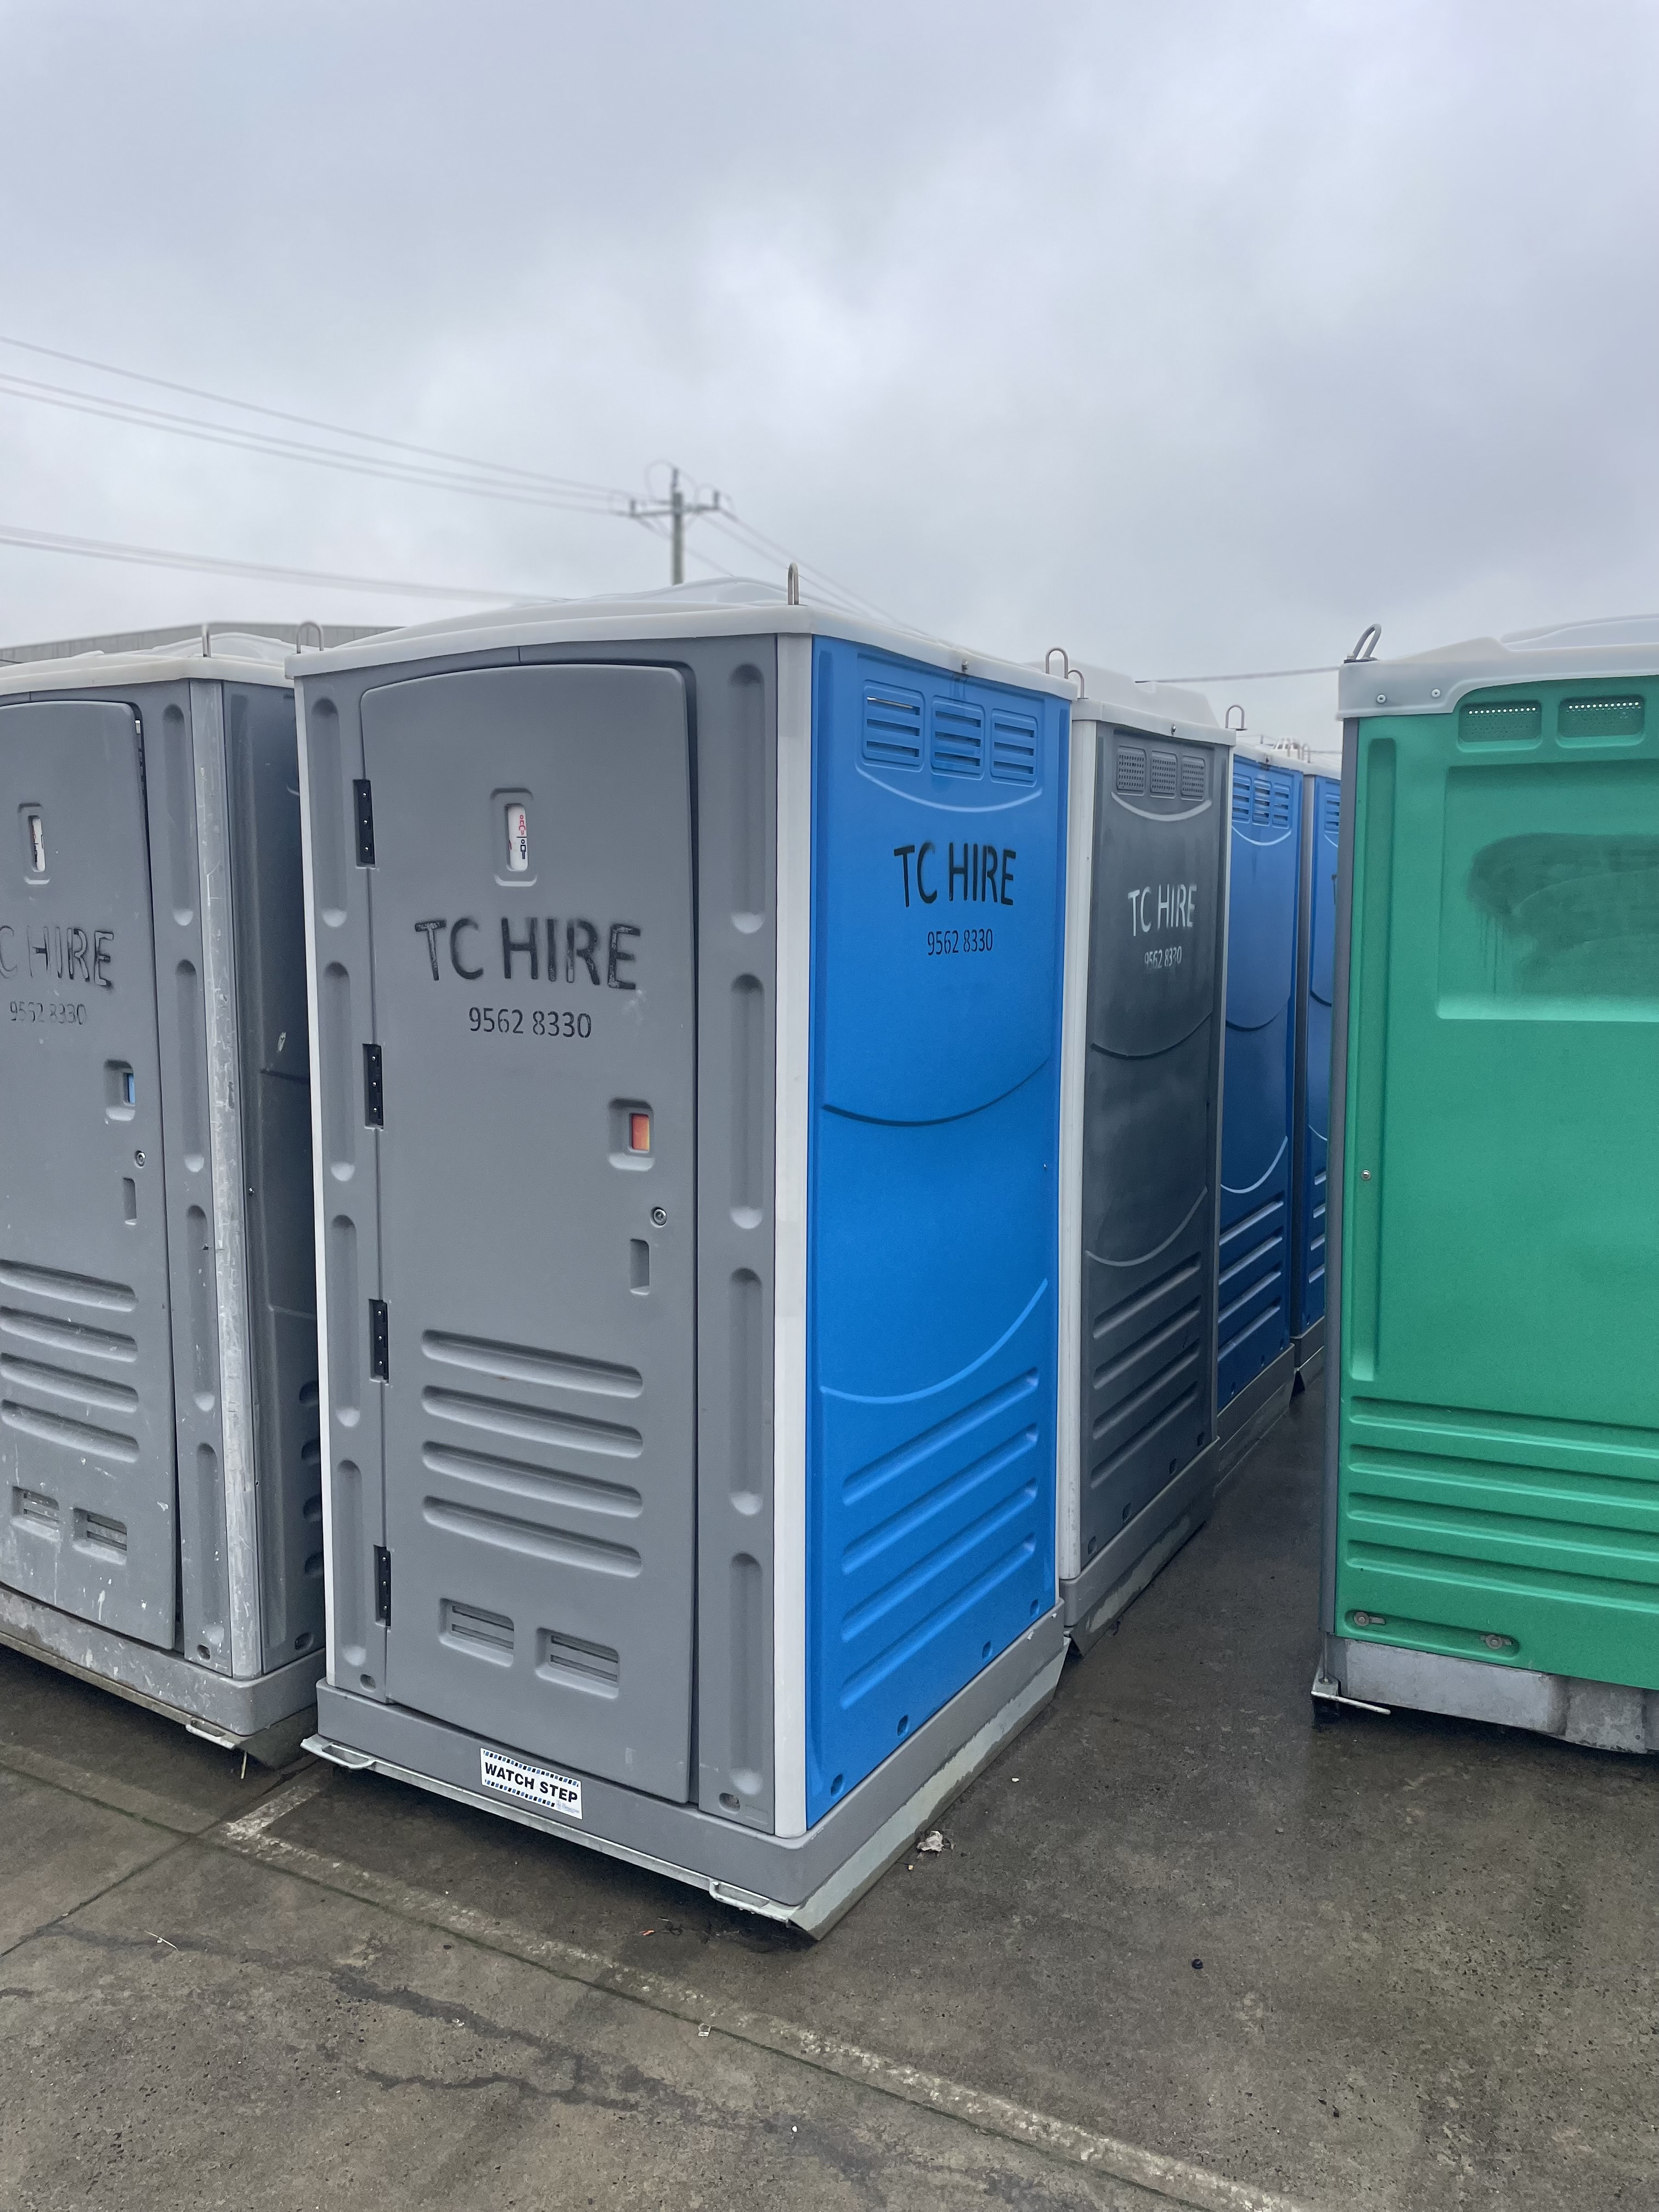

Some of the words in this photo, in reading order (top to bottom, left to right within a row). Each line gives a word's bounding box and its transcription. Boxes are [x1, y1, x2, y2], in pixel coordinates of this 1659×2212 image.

[894, 842, 937, 907] TC
[949, 842, 1016, 905] HIRE
[1128, 886, 1152, 936] TC
[1157, 883, 1197, 930] HIRE
[27, 926, 114, 988] HIRE
[415, 915, 484, 981] TC
[501, 917, 641, 990] HIRE
[927, 930, 959, 956] 9562
[963, 928, 993, 952] 8330
[1144, 949, 1163, 969] 9562
[10, 1001, 44, 1023] 9562
[469, 1007, 524, 1034] 9562
[533, 1011, 592, 1038] 8330
[485, 1762, 535, 1790] WATCH
[539, 1781, 578, 1803] STEP
